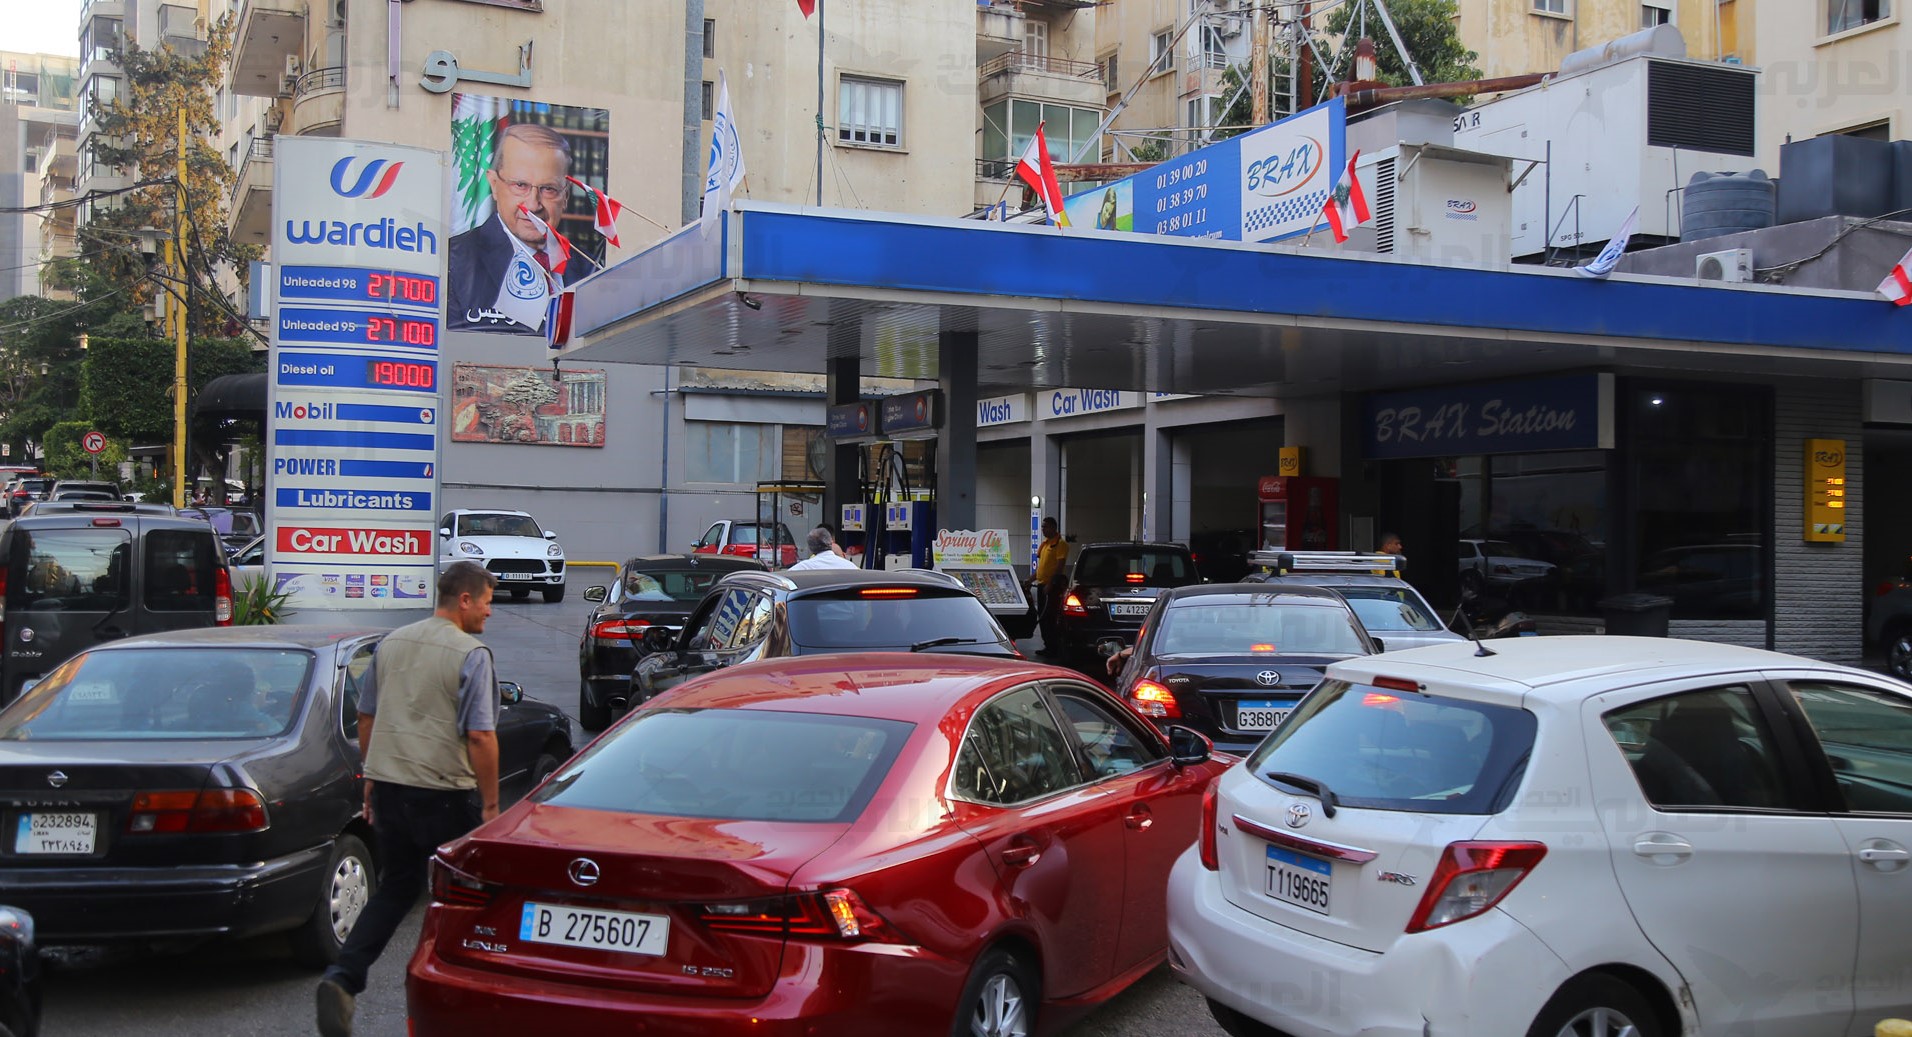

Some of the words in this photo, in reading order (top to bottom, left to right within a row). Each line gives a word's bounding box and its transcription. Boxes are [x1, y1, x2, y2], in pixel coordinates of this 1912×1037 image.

[1156, 173, 1167, 190] 01
[1170, 168, 1181, 186] 39
[1182, 164, 1194, 182] 00
[1195, 159, 1207, 176] 20
[1247, 144, 1313, 191] BRAX
[1156, 198, 1167, 214] 01
[1170, 193, 1181, 210] 38
[1182, 189, 1194, 205] 39
[1195, 183, 1207, 200] 70
[1157, 220, 1168, 235] 03
[1170, 215, 1181, 232] 88
[1182, 211, 1193, 228] 01
[1196, 207, 1206, 224] 11
[286, 217, 437, 254] wardieh
[283, 276, 341, 288] Unleaded
[342, 278, 357, 289] 98
[367, 273, 435, 303] 27700
[282, 319, 339, 331] Unleaded
[341, 321, 356, 332] 95
[366, 316, 434, 346] 27100
[281, 364, 317, 375] Diesel
[320, 365, 334, 376] oil
[374, 361, 433, 388] 19000
[275, 402, 333, 419] Mobil
[980, 399, 1011, 423] Wash
[1052, 391, 1077, 416] Car
[1081, 389, 1120, 411] Wash
[1375, 404, 1470, 442] BRAX
[1476, 400, 1577, 437] Station
[274, 458, 336, 476] POWER
[298, 489, 413, 510] Lubricants
[290, 529, 342, 553] Car
[347, 530, 419, 554] Wash
[936, 530, 977, 553] Spring
[980, 531, 1003, 547] Air
[1268, 865, 1329, 908] T119665
[538, 910, 552, 937] B
[564, 913, 651, 948] 275607
[463, 938, 507, 952] LEXUS
[682, 965, 698, 975] IS
[702, 967, 733, 978] 250
